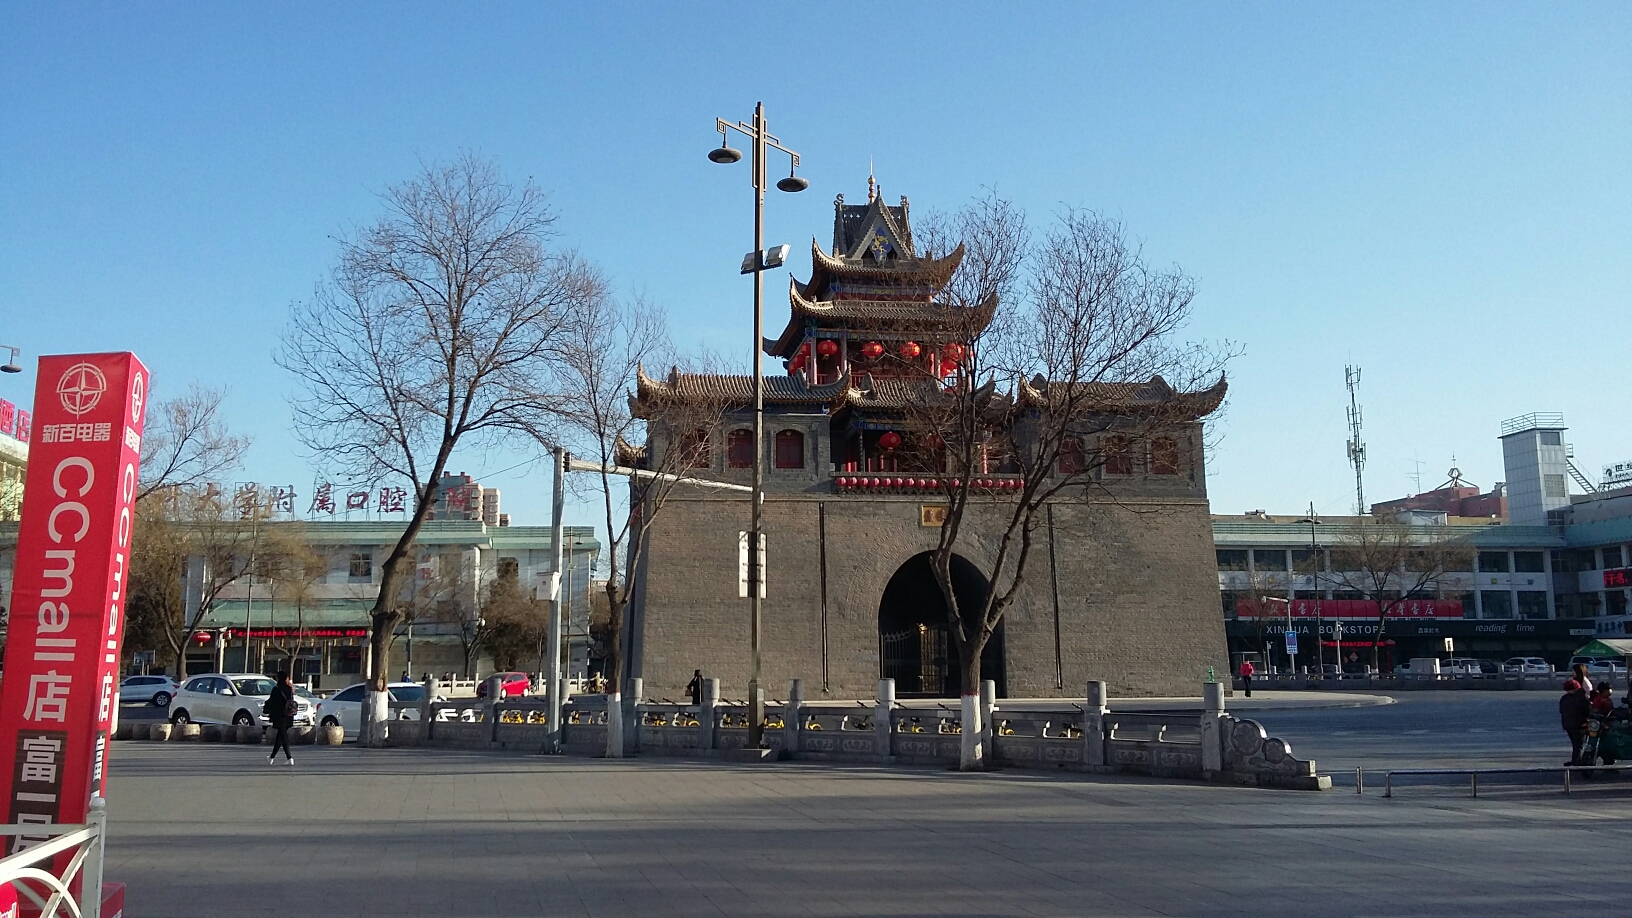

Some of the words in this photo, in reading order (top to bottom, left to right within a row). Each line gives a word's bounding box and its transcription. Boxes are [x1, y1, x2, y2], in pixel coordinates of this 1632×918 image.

[42, 423, 112, 443] 新百电器
[1475, 624, 1507, 634] reading
[1516, 624, 1535, 632] time
